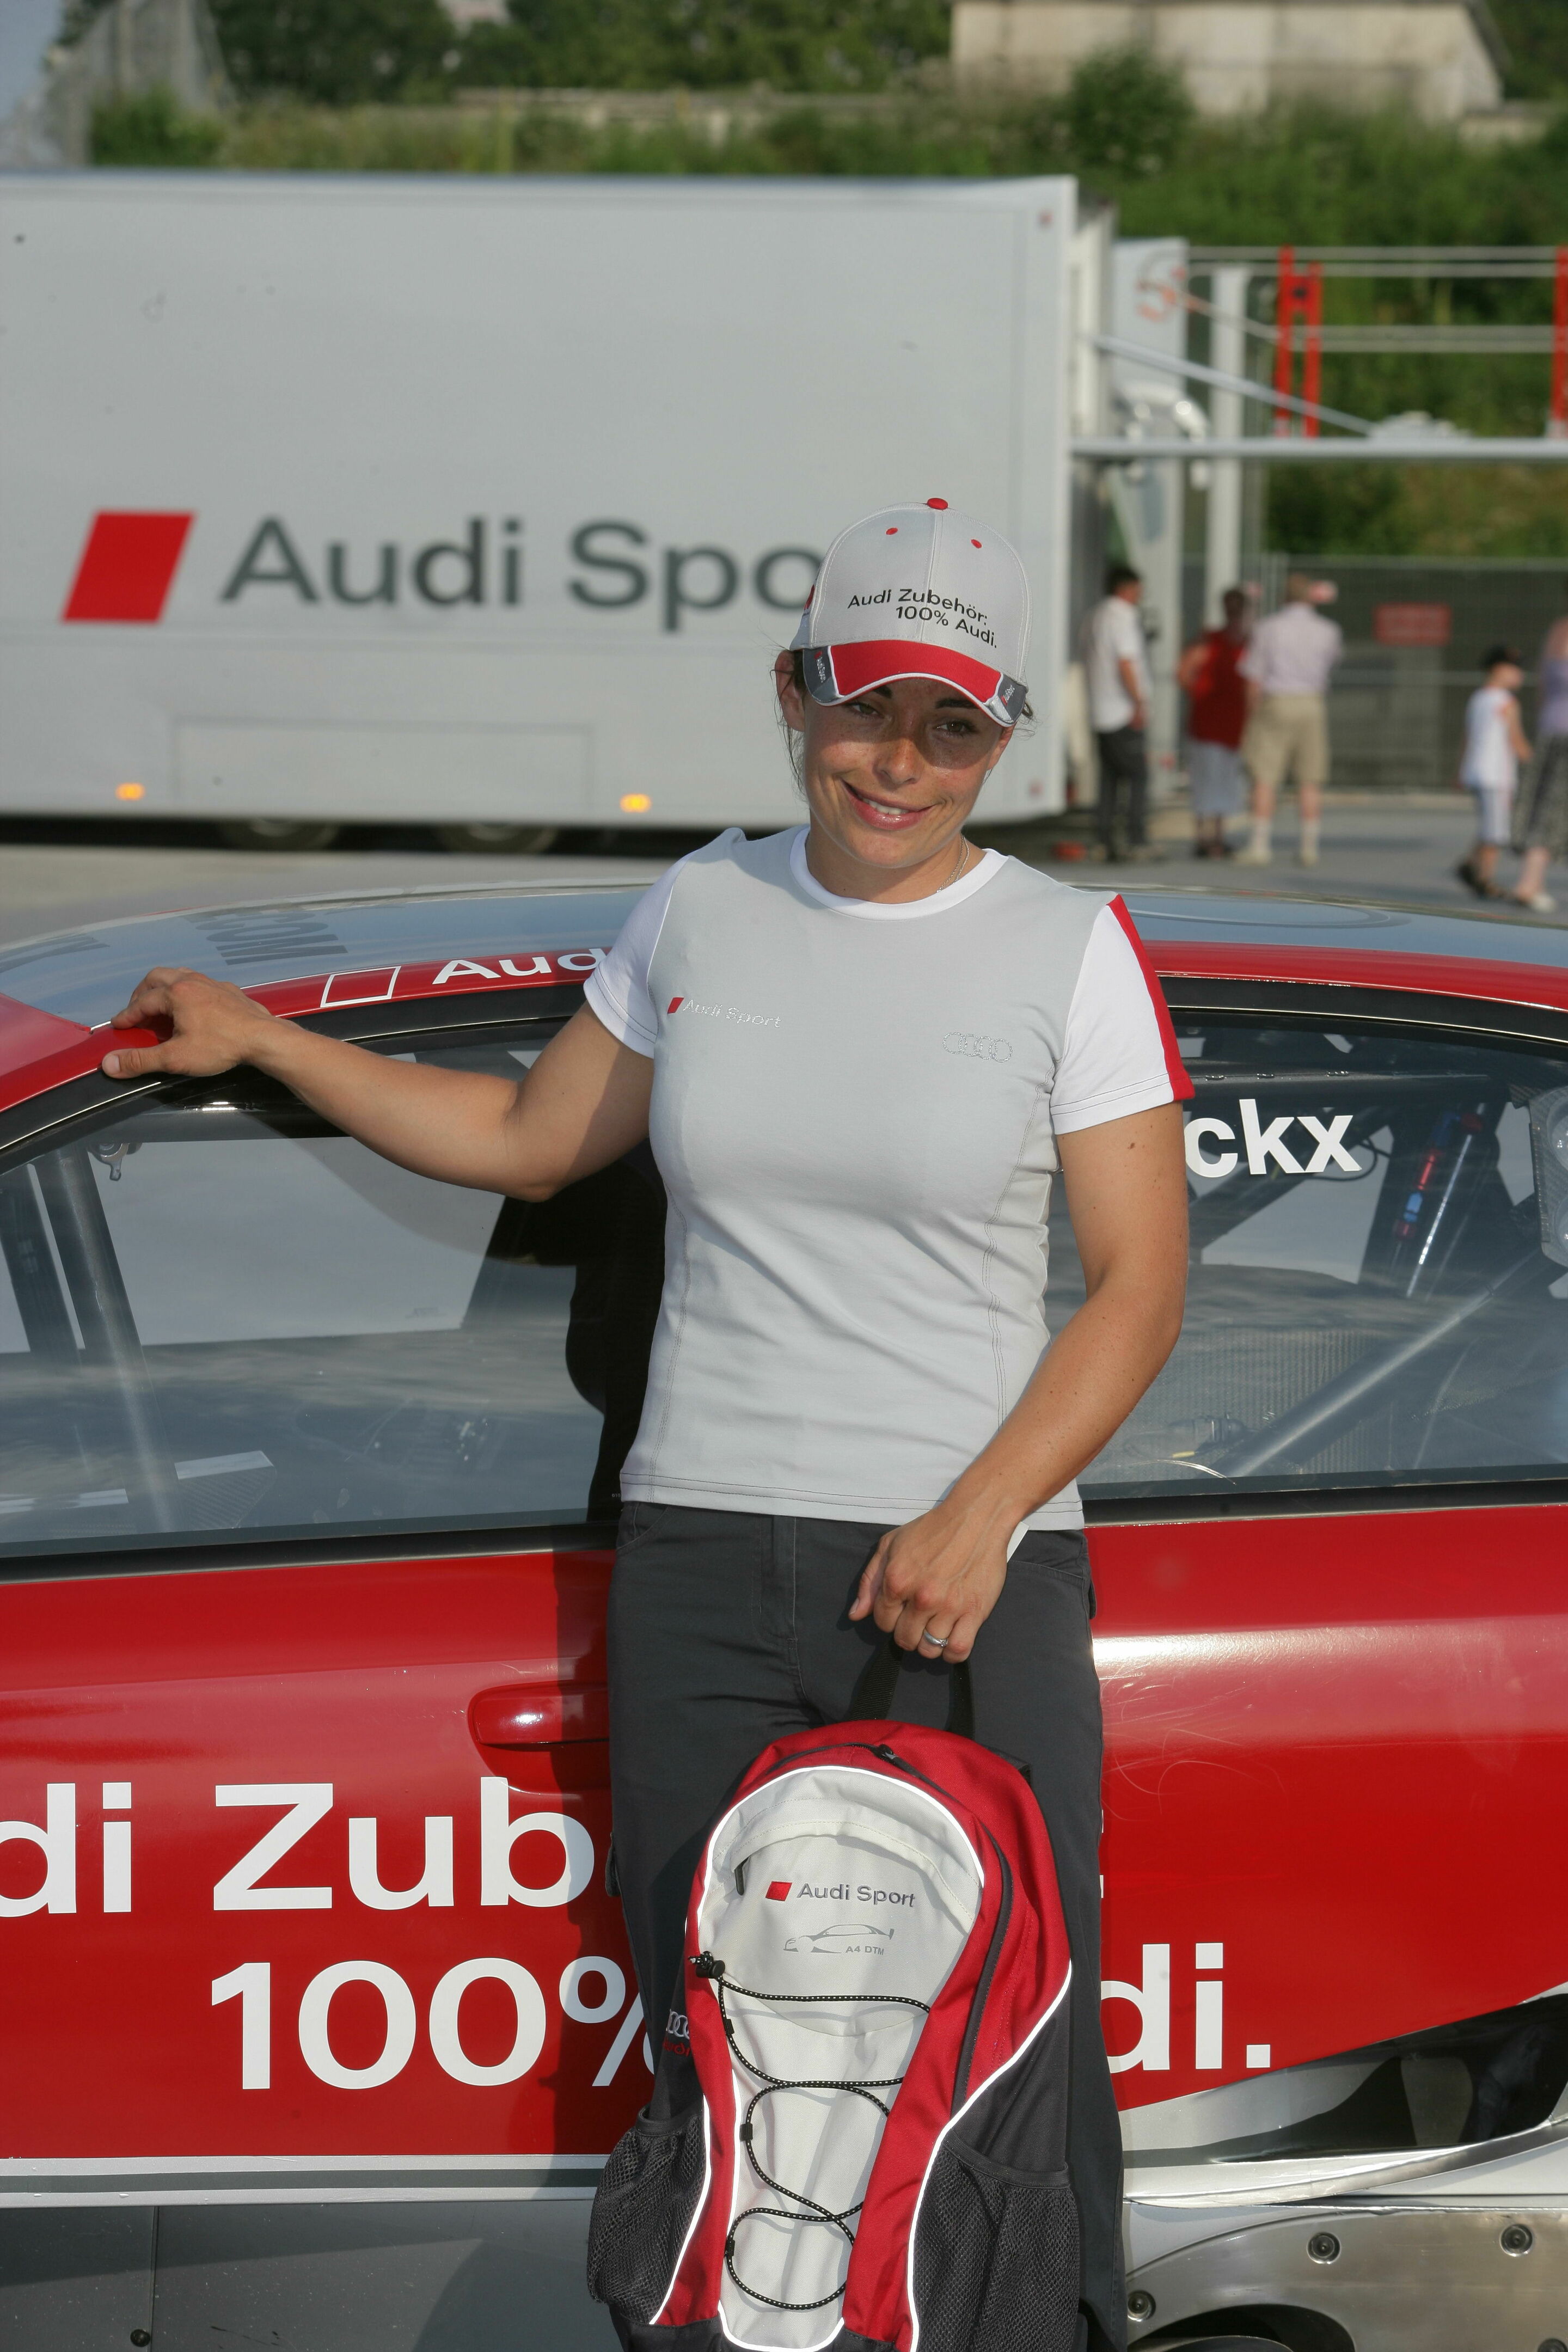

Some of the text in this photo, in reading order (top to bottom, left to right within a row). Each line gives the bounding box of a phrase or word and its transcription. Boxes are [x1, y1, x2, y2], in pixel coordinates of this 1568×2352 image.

[221, 516, 522, 609] Audi
[848, 589, 988, 626] Audi Zubehör:
[896, 606, 997, 648] 100% Audi.
[432, 948, 608, 984] Aud
[683, 999, 781, 1028] Audi Sport
[797, 1883, 916, 1908] Audi Sport
[846, 1945, 885, 1956] A4 DTM
